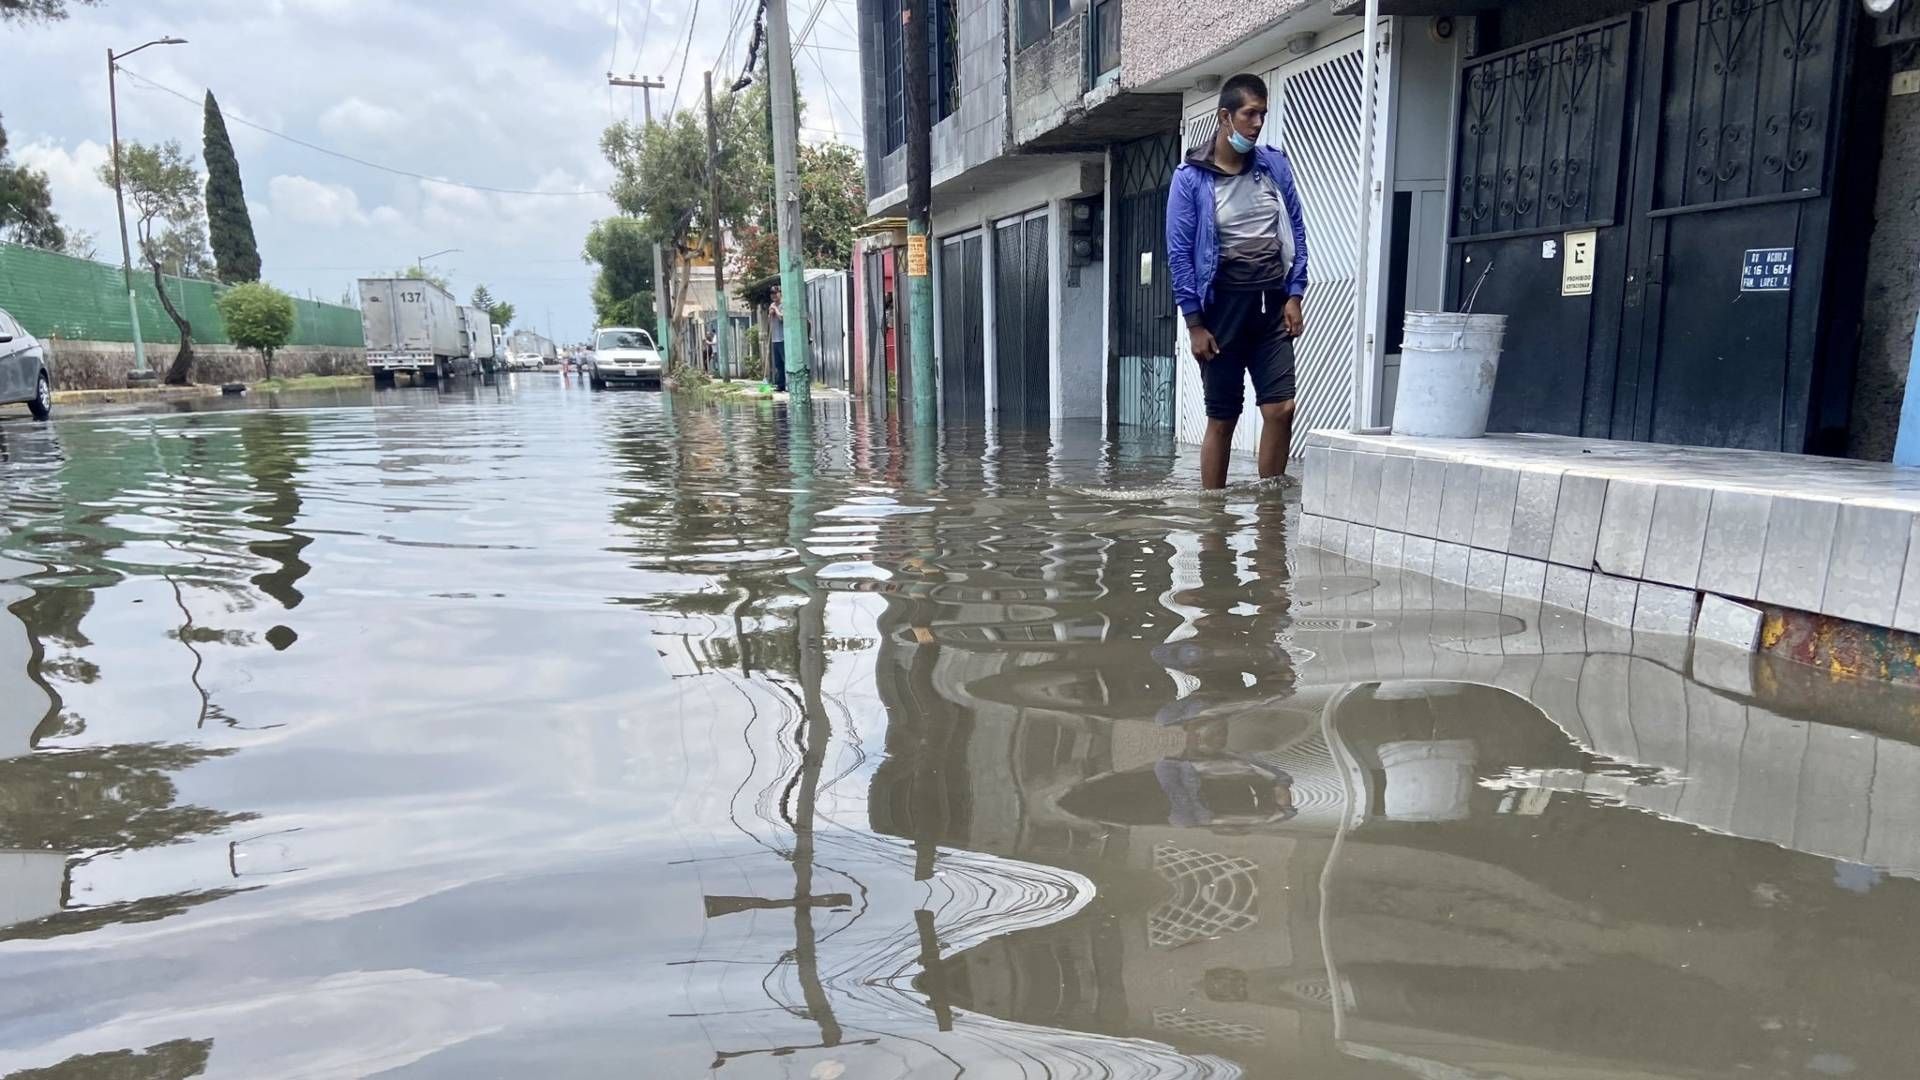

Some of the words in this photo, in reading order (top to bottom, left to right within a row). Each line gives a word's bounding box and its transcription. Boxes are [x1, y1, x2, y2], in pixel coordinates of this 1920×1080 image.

[1753, 264, 1763, 275] 16
[1566, 274, 1592, 282] PROHIBIDO
[400, 292, 421, 303] 137
